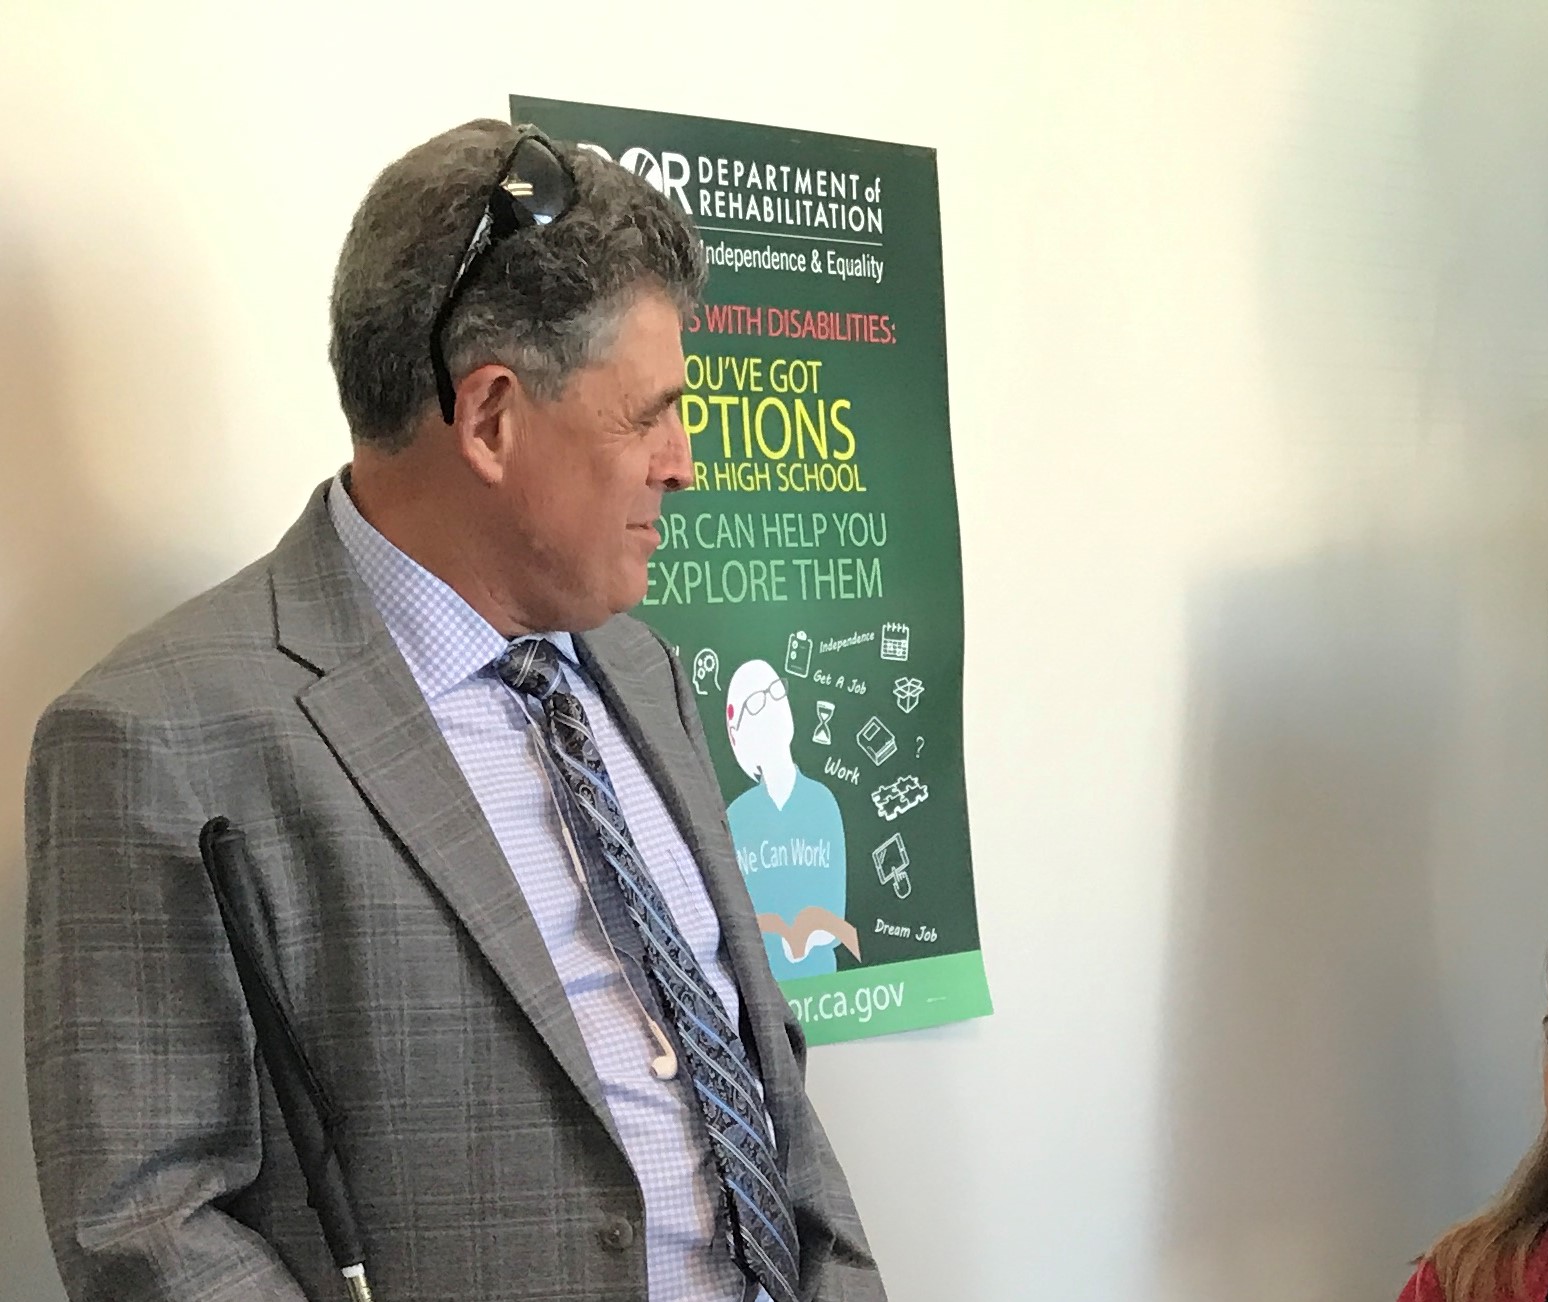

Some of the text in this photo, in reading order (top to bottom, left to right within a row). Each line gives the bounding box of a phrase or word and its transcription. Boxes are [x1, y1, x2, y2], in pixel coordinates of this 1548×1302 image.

[577, 142, 693, 215] OR
[698, 156, 881, 203] DEPARTMENT of
[699, 189, 883, 234] REHABILITATION
[810, 249, 823, 274] &
[827, 250, 884, 284] Equality
[704, 304, 762, 337] WITH
[767, 308, 897, 344] DISABILITIES:
[684, 354, 823, 394] OU'VE GOT
[681, 395, 856, 461] PTIONS
[714, 462, 772, 492] HIGH
[776, 463, 867, 492] SCHOOL
[695, 513, 755, 549] CAN
[761, 512, 828, 548] HELP
[832, 512, 888, 547] YOU
[642, 558, 883, 606] EXPLORE THEM
[819, 631, 876, 653] Independence
[813, 670, 867, 695] Get A Job
[824, 756, 860, 785] Work
[760, 840, 789, 868] Can
[791, 838, 831, 868] Work!
[874, 918, 938, 943] Dream Job
[788, 981, 905, 1023] or.ca.gov
